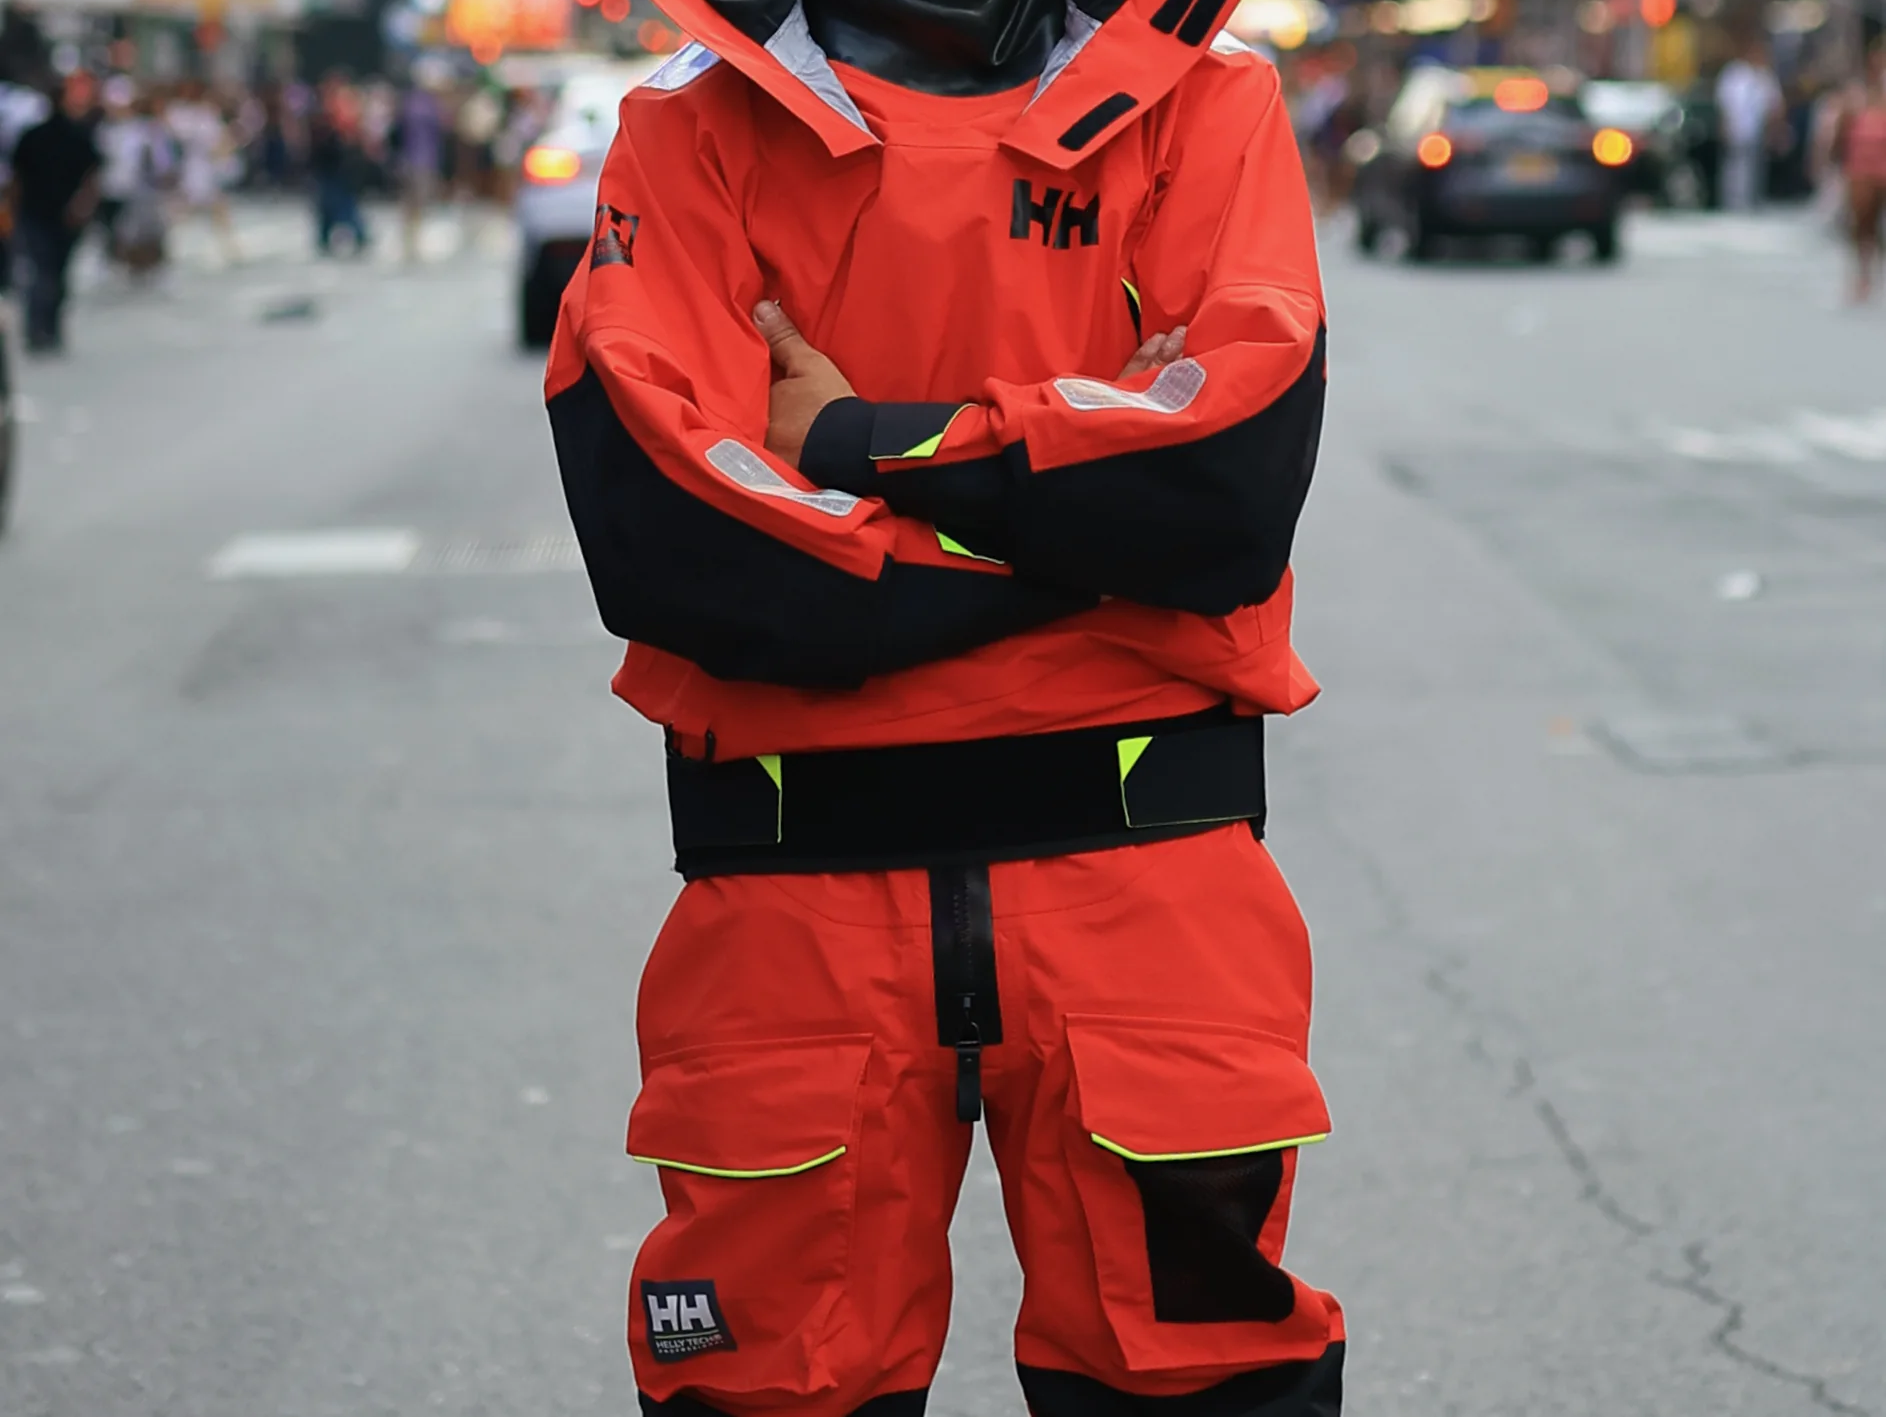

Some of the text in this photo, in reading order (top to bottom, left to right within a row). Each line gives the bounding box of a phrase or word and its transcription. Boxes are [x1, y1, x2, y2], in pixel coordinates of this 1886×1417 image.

[1010, 178, 1100, 250] HH
[647, 1293, 716, 1332] HH
[655, 1338, 685, 1350] HELLY
